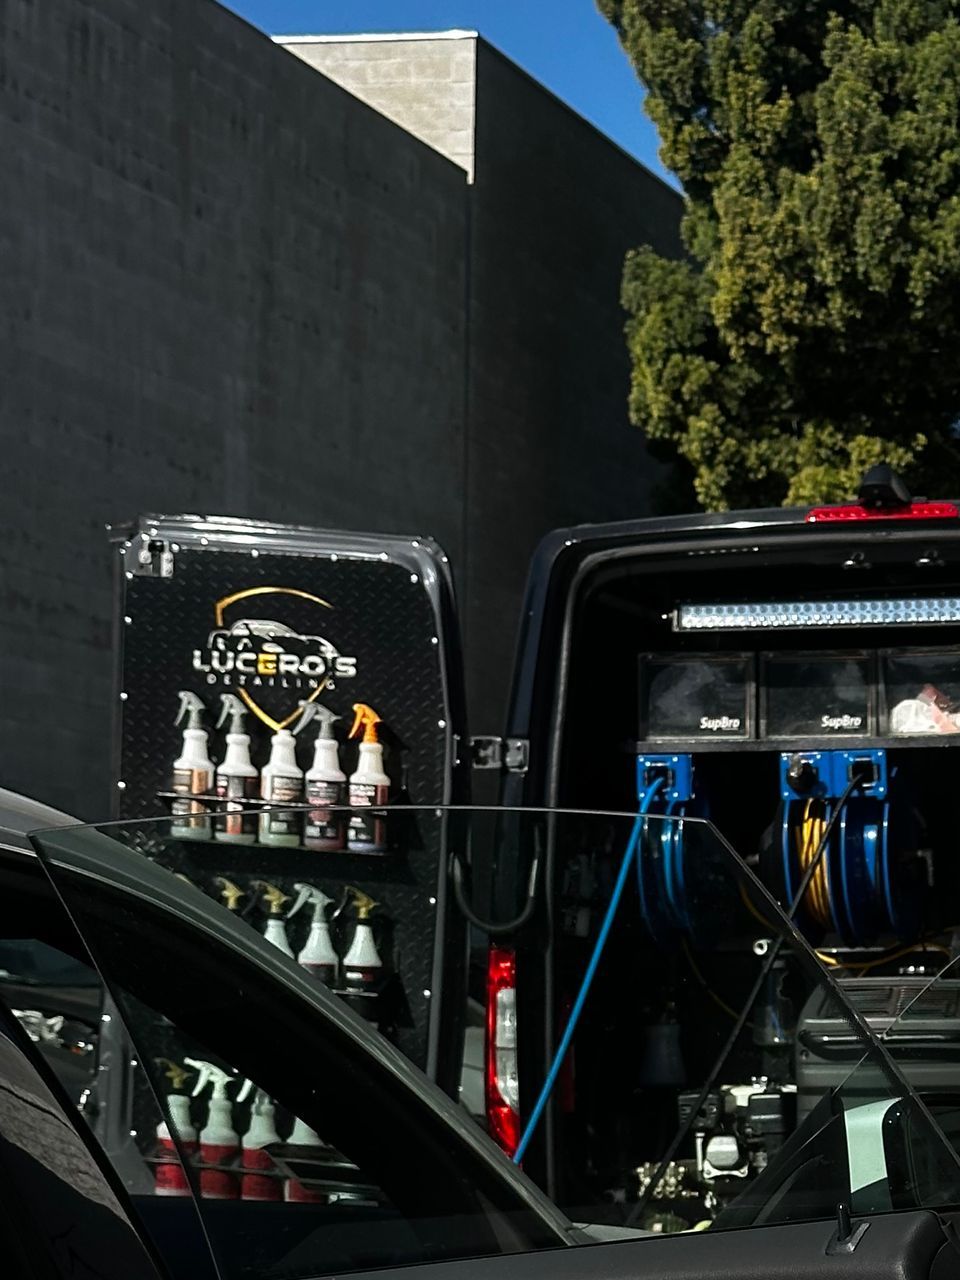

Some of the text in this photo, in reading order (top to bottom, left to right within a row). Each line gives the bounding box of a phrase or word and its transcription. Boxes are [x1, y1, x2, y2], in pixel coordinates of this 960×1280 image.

[193, 650, 357, 677] LUCERO'S
[207, 674, 335, 690] DETAILING
[700, 716, 740, 730] SupBro
[821, 714, 861, 729] SupBro
